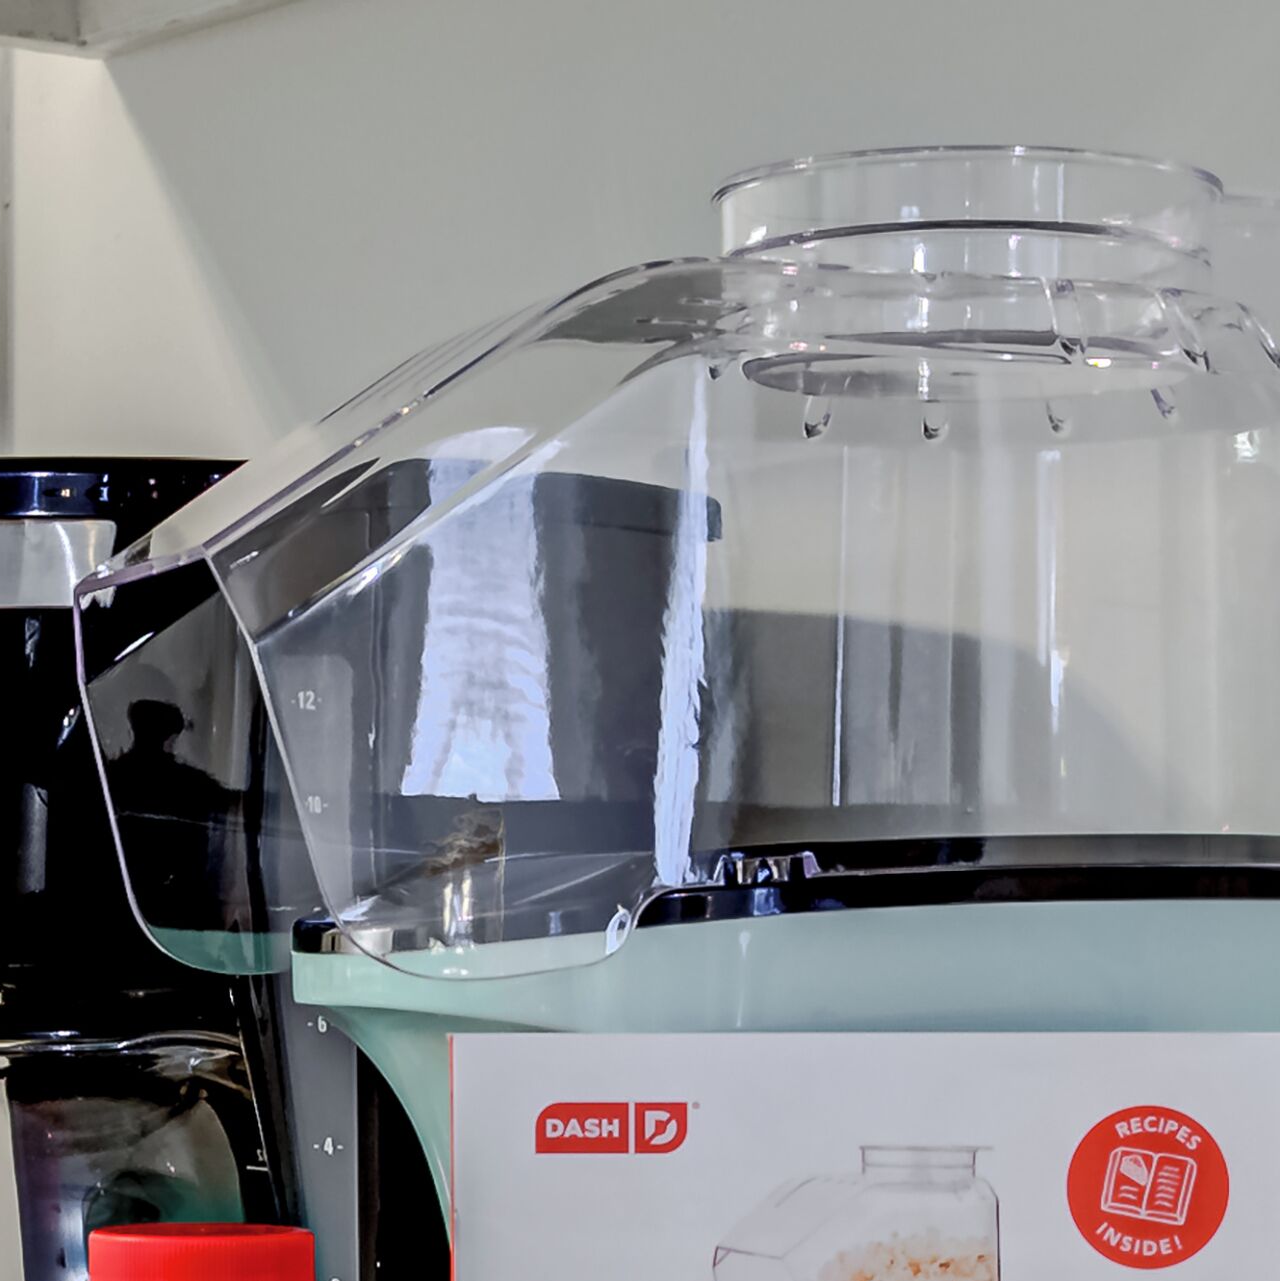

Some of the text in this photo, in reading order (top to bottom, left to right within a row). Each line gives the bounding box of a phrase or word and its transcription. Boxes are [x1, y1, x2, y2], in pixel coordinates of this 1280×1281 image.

[545, 1118, 620, 1138] DASH
[1115, 1116, 1201, 1150] RECIPES
[1096, 1222, 1182, 1256] INSIDE!
